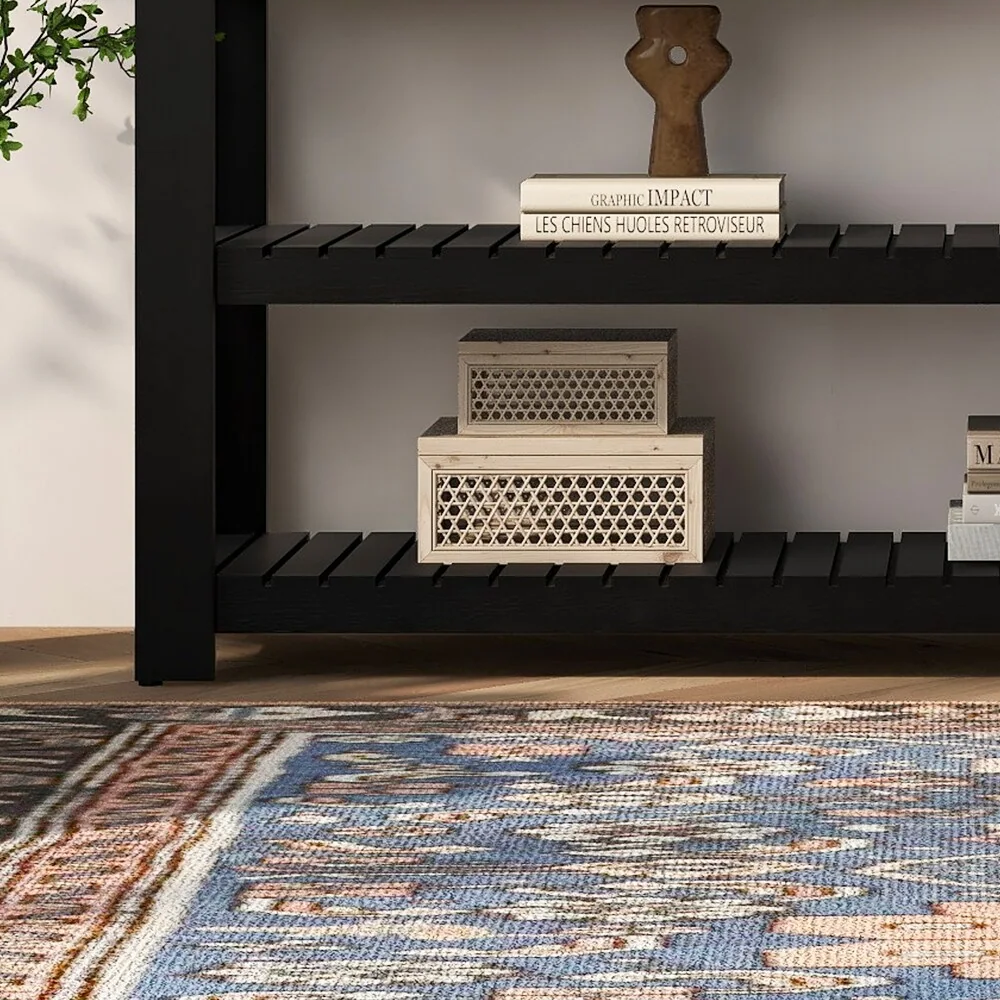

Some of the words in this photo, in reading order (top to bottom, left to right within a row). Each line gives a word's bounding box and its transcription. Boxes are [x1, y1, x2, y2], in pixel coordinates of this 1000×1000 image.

[590, 193, 645, 207] GRAPHIC
[648, 189, 713, 207] IMPACT
[535, 215, 558, 233] LES
[561, 215, 612, 233] CHIENS
[616, 215, 669, 233] HUOLES
[674, 215, 765, 233] RETROVISEUR
